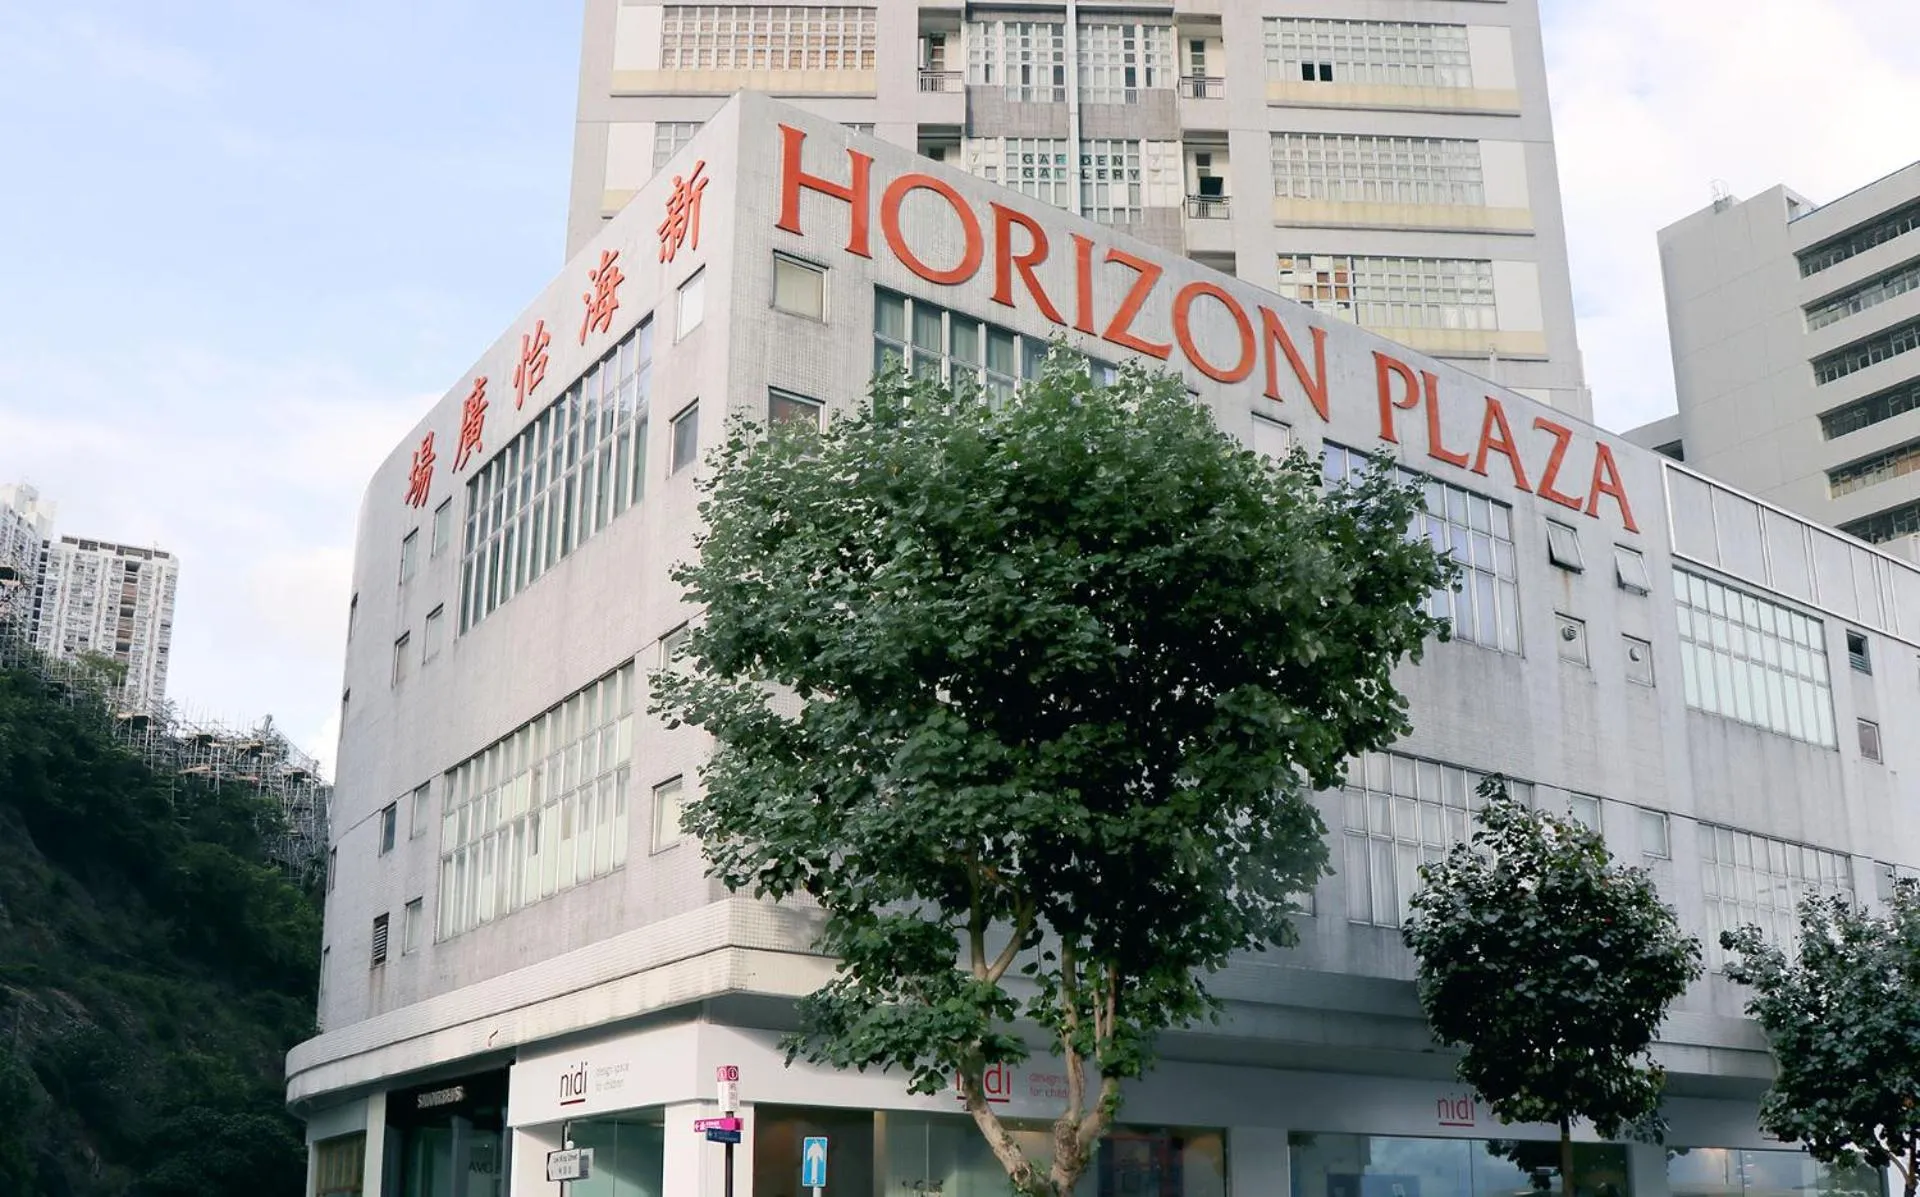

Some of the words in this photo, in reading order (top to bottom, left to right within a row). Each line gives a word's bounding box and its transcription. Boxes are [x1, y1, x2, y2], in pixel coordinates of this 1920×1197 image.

[1022, 153, 1124, 167] GARDEN
[1022, 168, 1140, 181] GALLERY
[775, 123, 1329, 422] HORIZON
[1371, 349, 1640, 535] PLAZA
[560, 1061, 588, 1098] nidi
[1438, 1092, 1474, 1120] nidi
